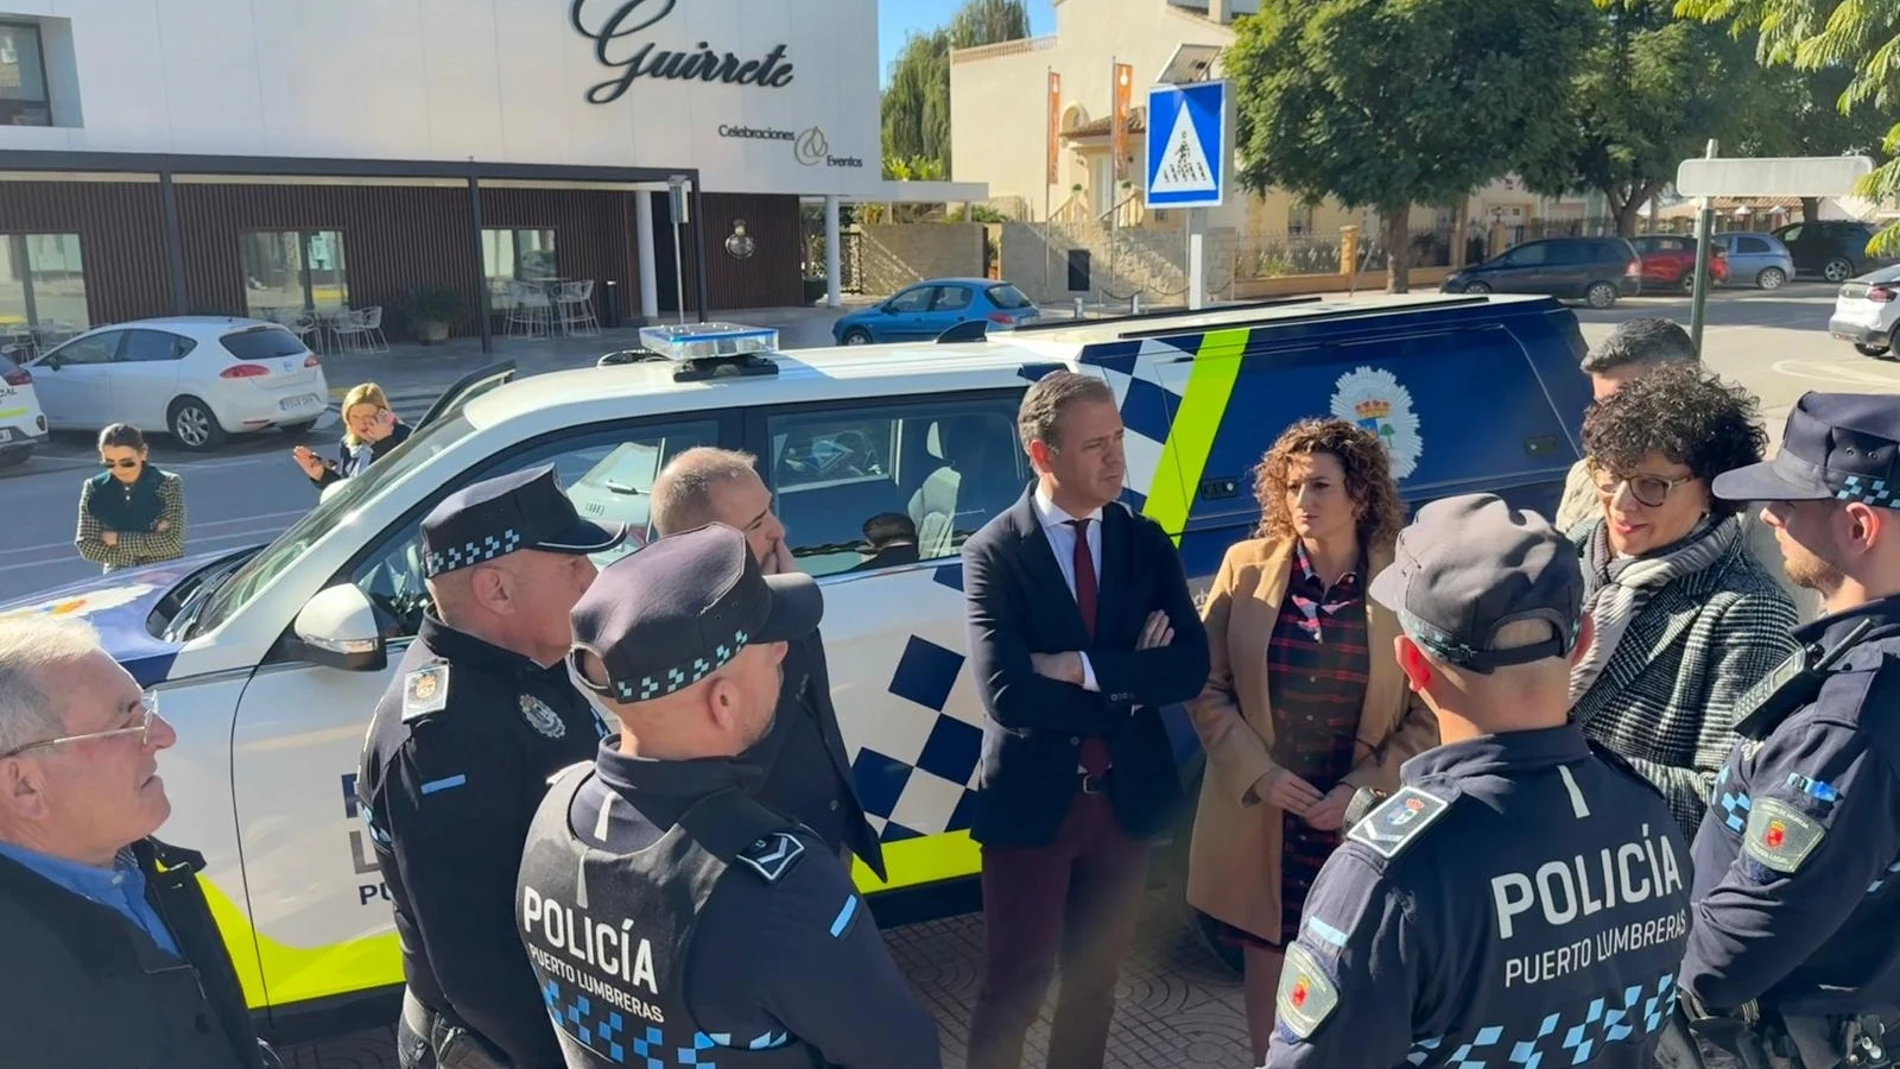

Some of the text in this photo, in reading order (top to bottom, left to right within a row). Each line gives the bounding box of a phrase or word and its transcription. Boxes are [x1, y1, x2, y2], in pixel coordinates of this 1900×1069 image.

[571, 0, 795, 105] Guirrete
[718, 124, 796, 141] Celebraciones
[826, 155, 864, 168] Eventos
[1490, 823, 1683, 940] POLICÍA
[523, 884, 659, 996] POLICÍA
[528, 942, 665, 1024] PUERTO LUMBRERAS
[1504, 908, 1687, 988] PUERTO LUMBRERAS
